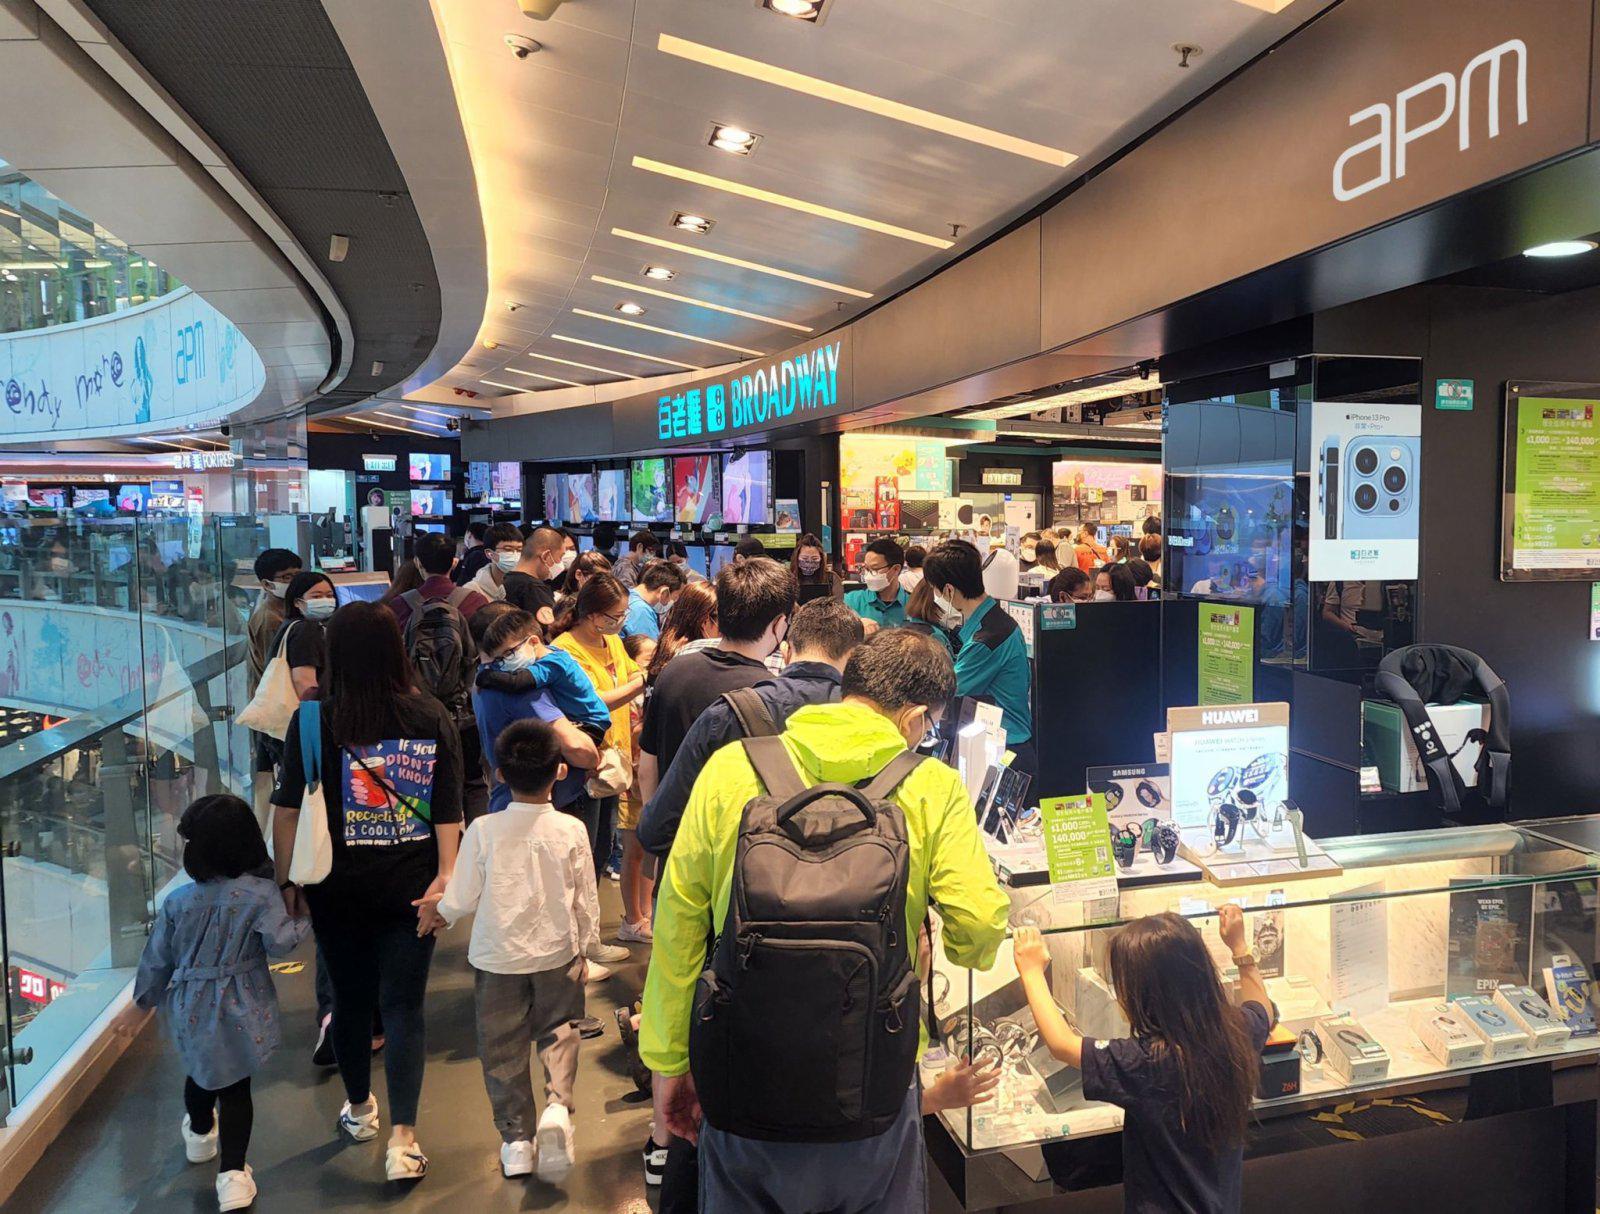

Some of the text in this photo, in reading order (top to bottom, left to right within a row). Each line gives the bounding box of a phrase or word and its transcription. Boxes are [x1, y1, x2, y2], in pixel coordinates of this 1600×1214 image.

[730, 341, 841, 429] BROADWAY
[1351, 413, 1371, 421] iPhone
[1371, 413, 1379, 421] 13
[1202, 709, 1259, 724] HUAWEI
[413, 743, 437, 755] you
[386, 753, 437, 773] DIDN'T
[398, 768, 433, 785] KNOW
[1112, 768, 1146, 777] SAMSUNG
[345, 824, 356, 837] IS
[1051, 821, 1078, 833] $1,000
[1052, 832, 1087, 844] 140,000
[1476, 979, 1500, 990] EPIX
